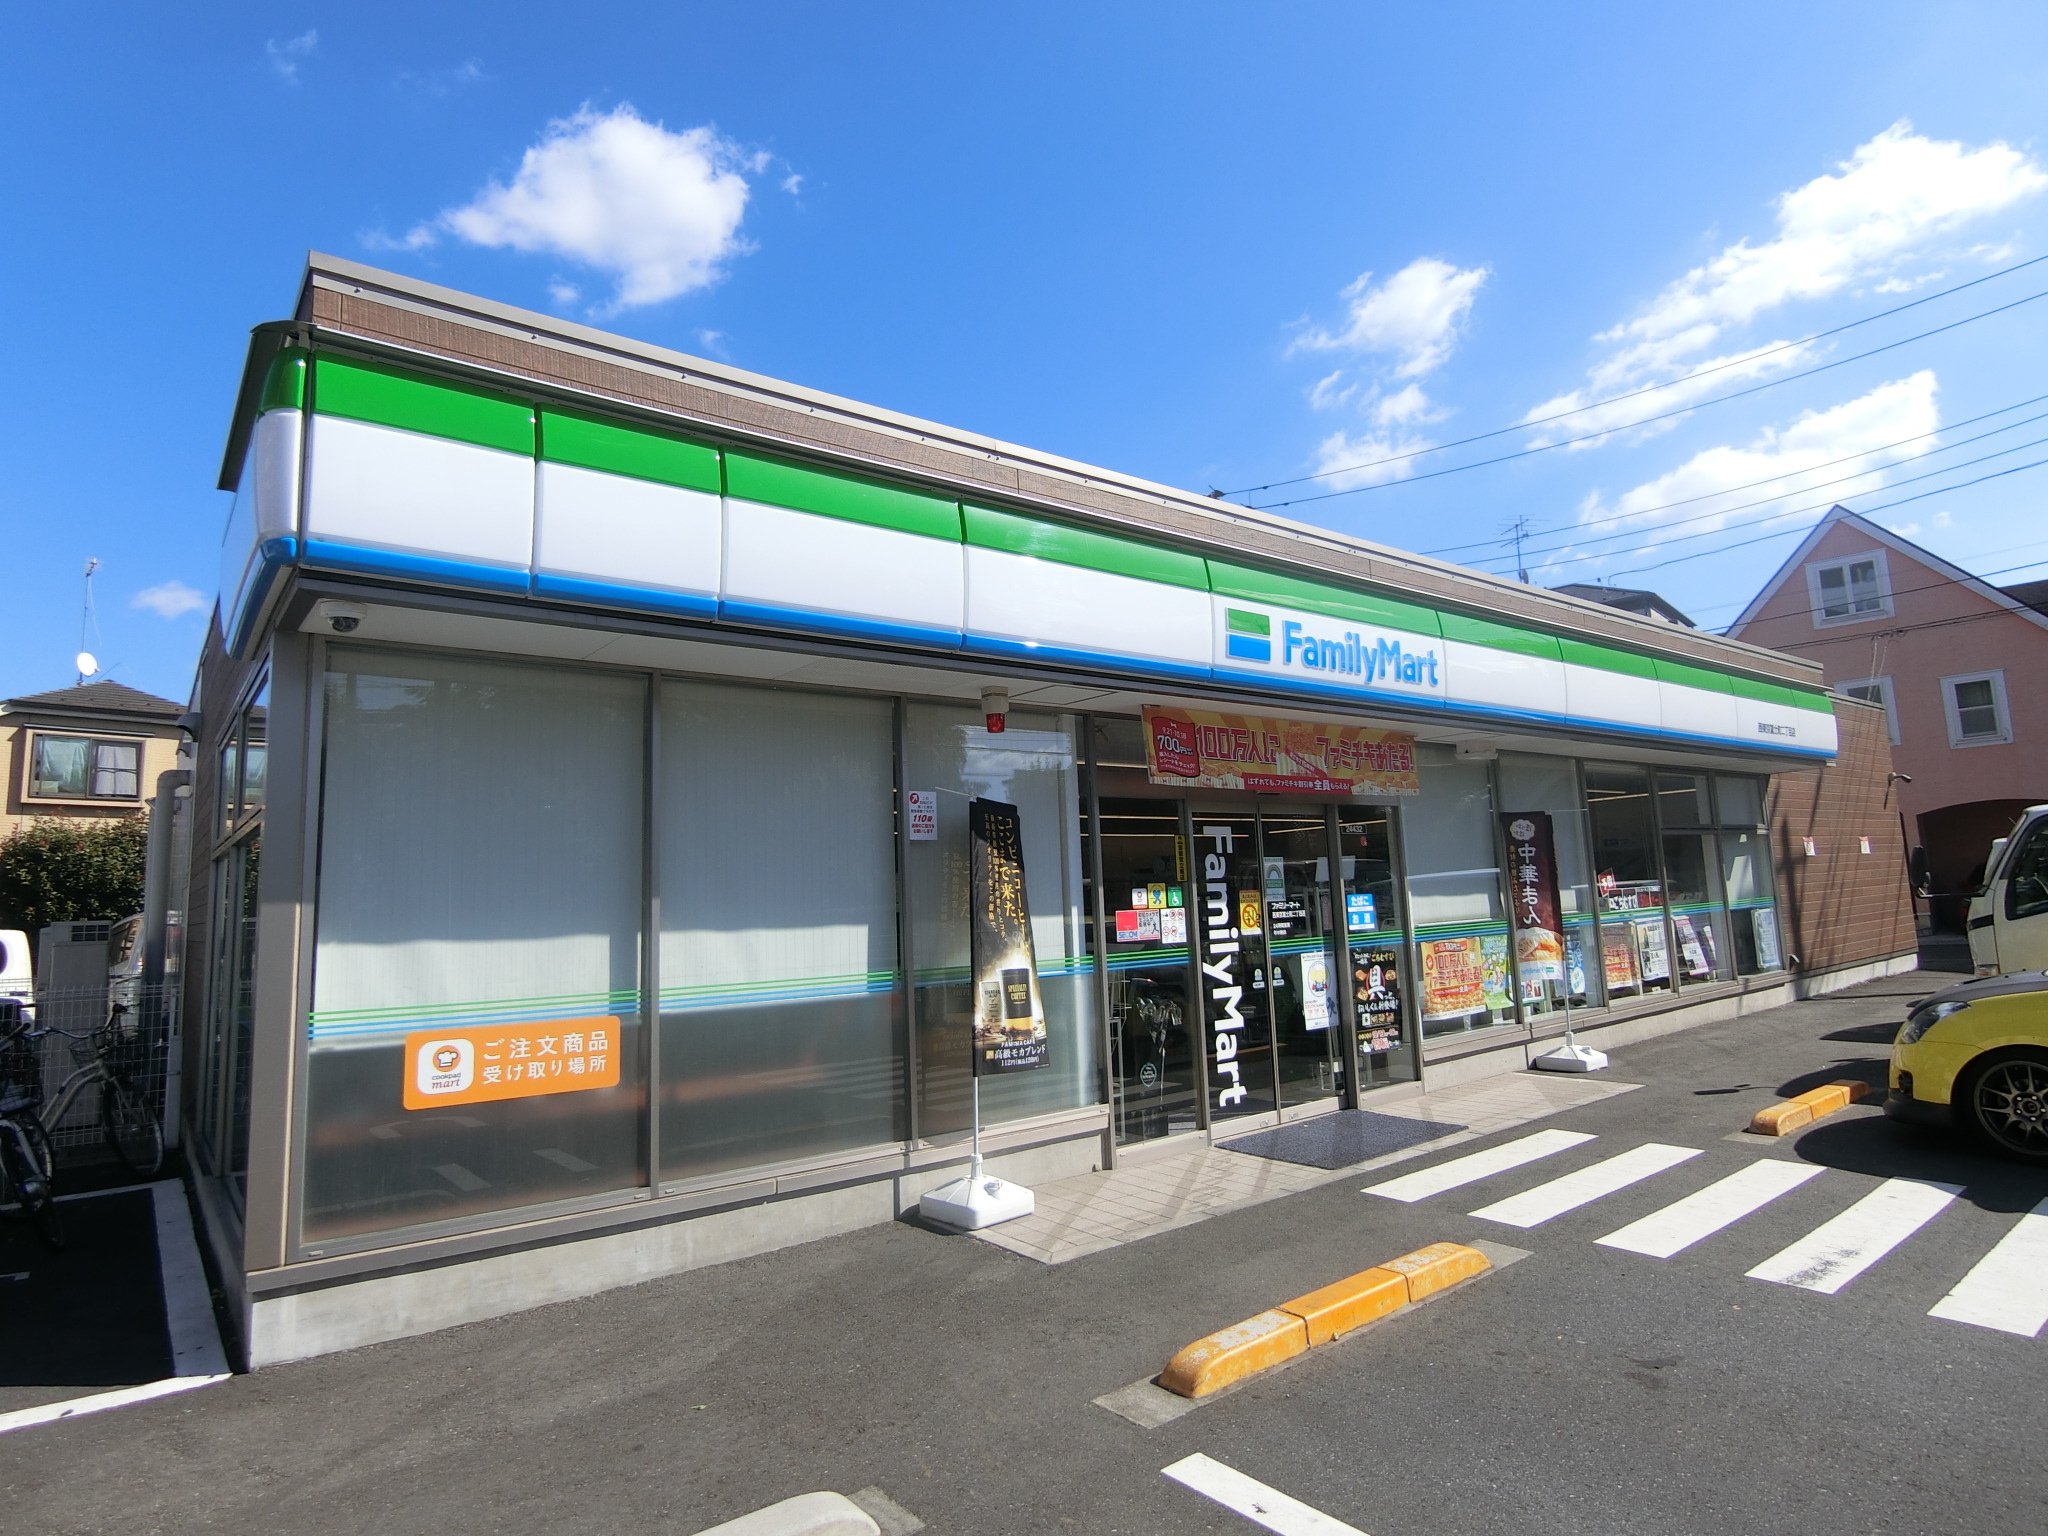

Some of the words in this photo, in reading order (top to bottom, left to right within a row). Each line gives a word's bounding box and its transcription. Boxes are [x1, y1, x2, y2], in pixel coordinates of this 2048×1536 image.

[1282, 620, 1438, 687] FamilyMart
[1196, 723, 1280, 765] 100万人に
[1351, 896, 1369, 906] たばこ
[1118, 930, 1138, 939] SECOM
[1202, 826, 1248, 1107] FamilyMart
[1435, 952, 1469, 970] 100万人に
[482, 1030, 609, 1061] ご注文商品
[431, 1071, 462, 1081] cookpad
[482, 1054, 607, 1085] 受け取り場所
[431, 1077, 461, 1090] mart
